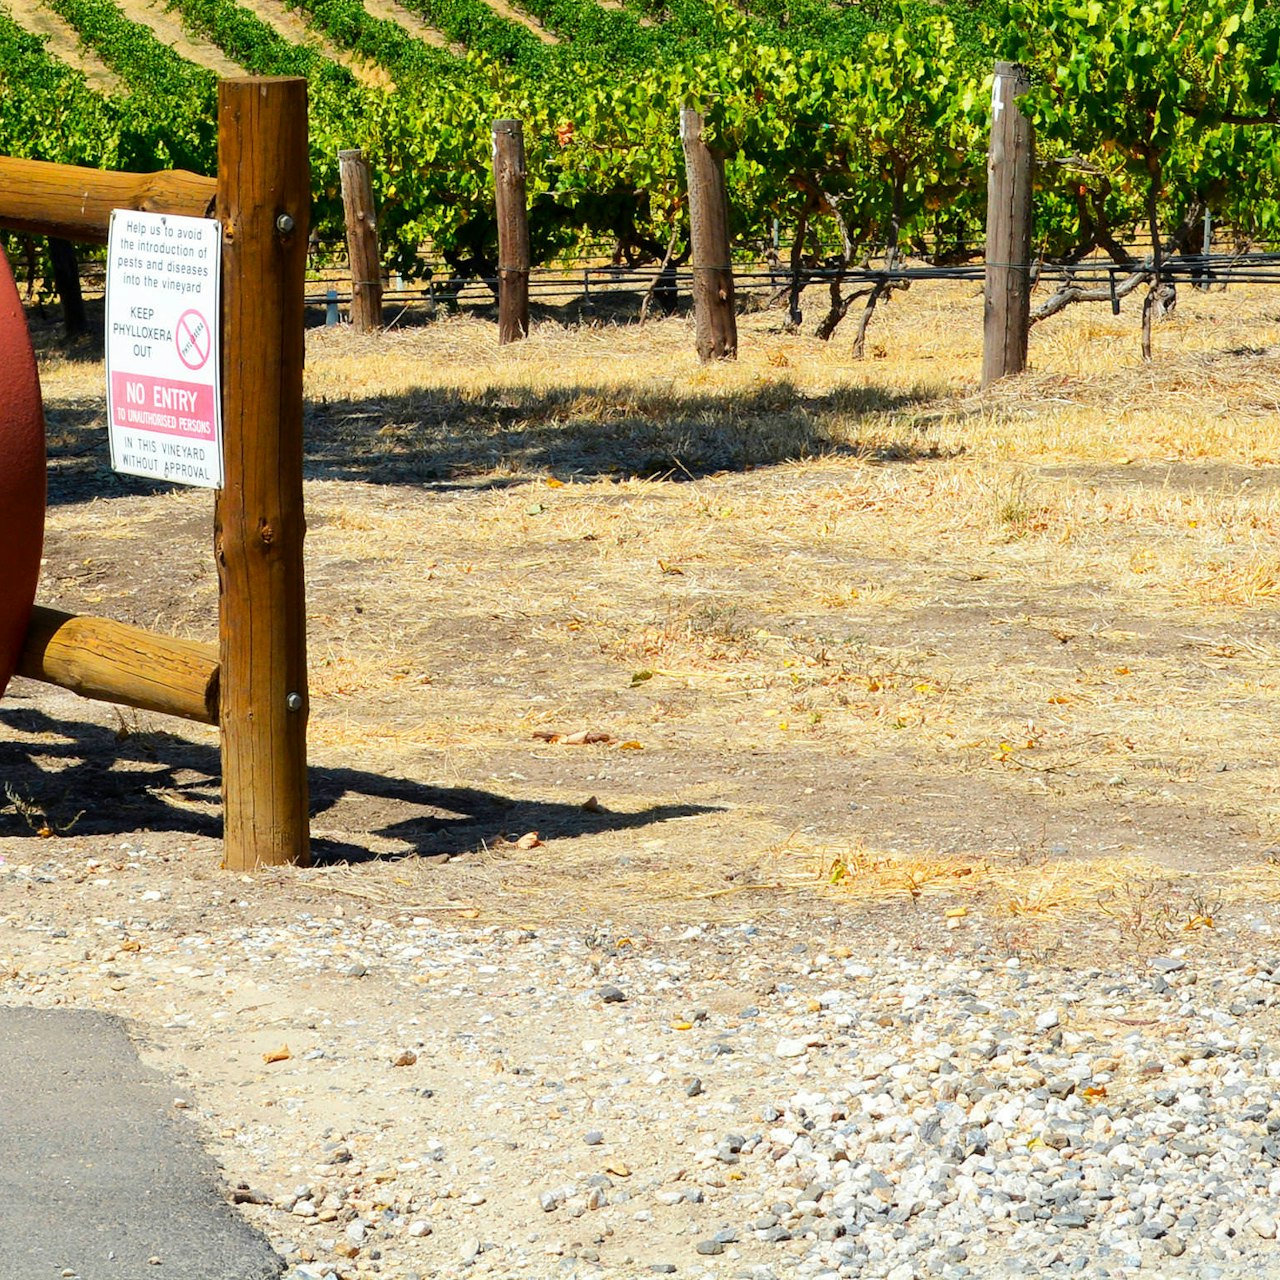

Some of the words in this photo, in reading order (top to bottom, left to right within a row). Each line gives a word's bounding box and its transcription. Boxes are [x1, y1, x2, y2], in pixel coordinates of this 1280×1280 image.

[991, 75, 1005, 122] 4
[126, 220, 146, 236] Help
[150, 225, 161, 236] us
[164, 225, 174, 237] to
[177, 228, 202, 240] avoid
[120, 238, 134, 250] the
[138, 239, 194, 257] introduction
[198, 247, 207, 259] of
[117, 256, 143, 269] pests
[146, 260, 163, 271] and
[167, 261, 208, 277] diseases
[123, 272, 140, 286] into
[144, 275, 158, 288] the
[162, 277, 202, 294] vineyard
[130, 306, 154, 320] KEEP
[113, 322, 173, 342] PHYLLOXERA
[133, 344, 152, 358] OUT
[126, 381, 145, 405] NO
[153, 385, 198, 413] ENTRY
[117, 407, 126, 421] TO
[127, 408, 177, 429] UNAUTHORISED
[179, 417, 211, 435] PERSONS
[124, 436, 133, 448] IN
[138, 438, 157, 453] THIS
[161, 443, 205, 461] VINEYARD
[122, 454, 158, 471] WITHOUT
[164, 461, 210, 480] APPROVAL
